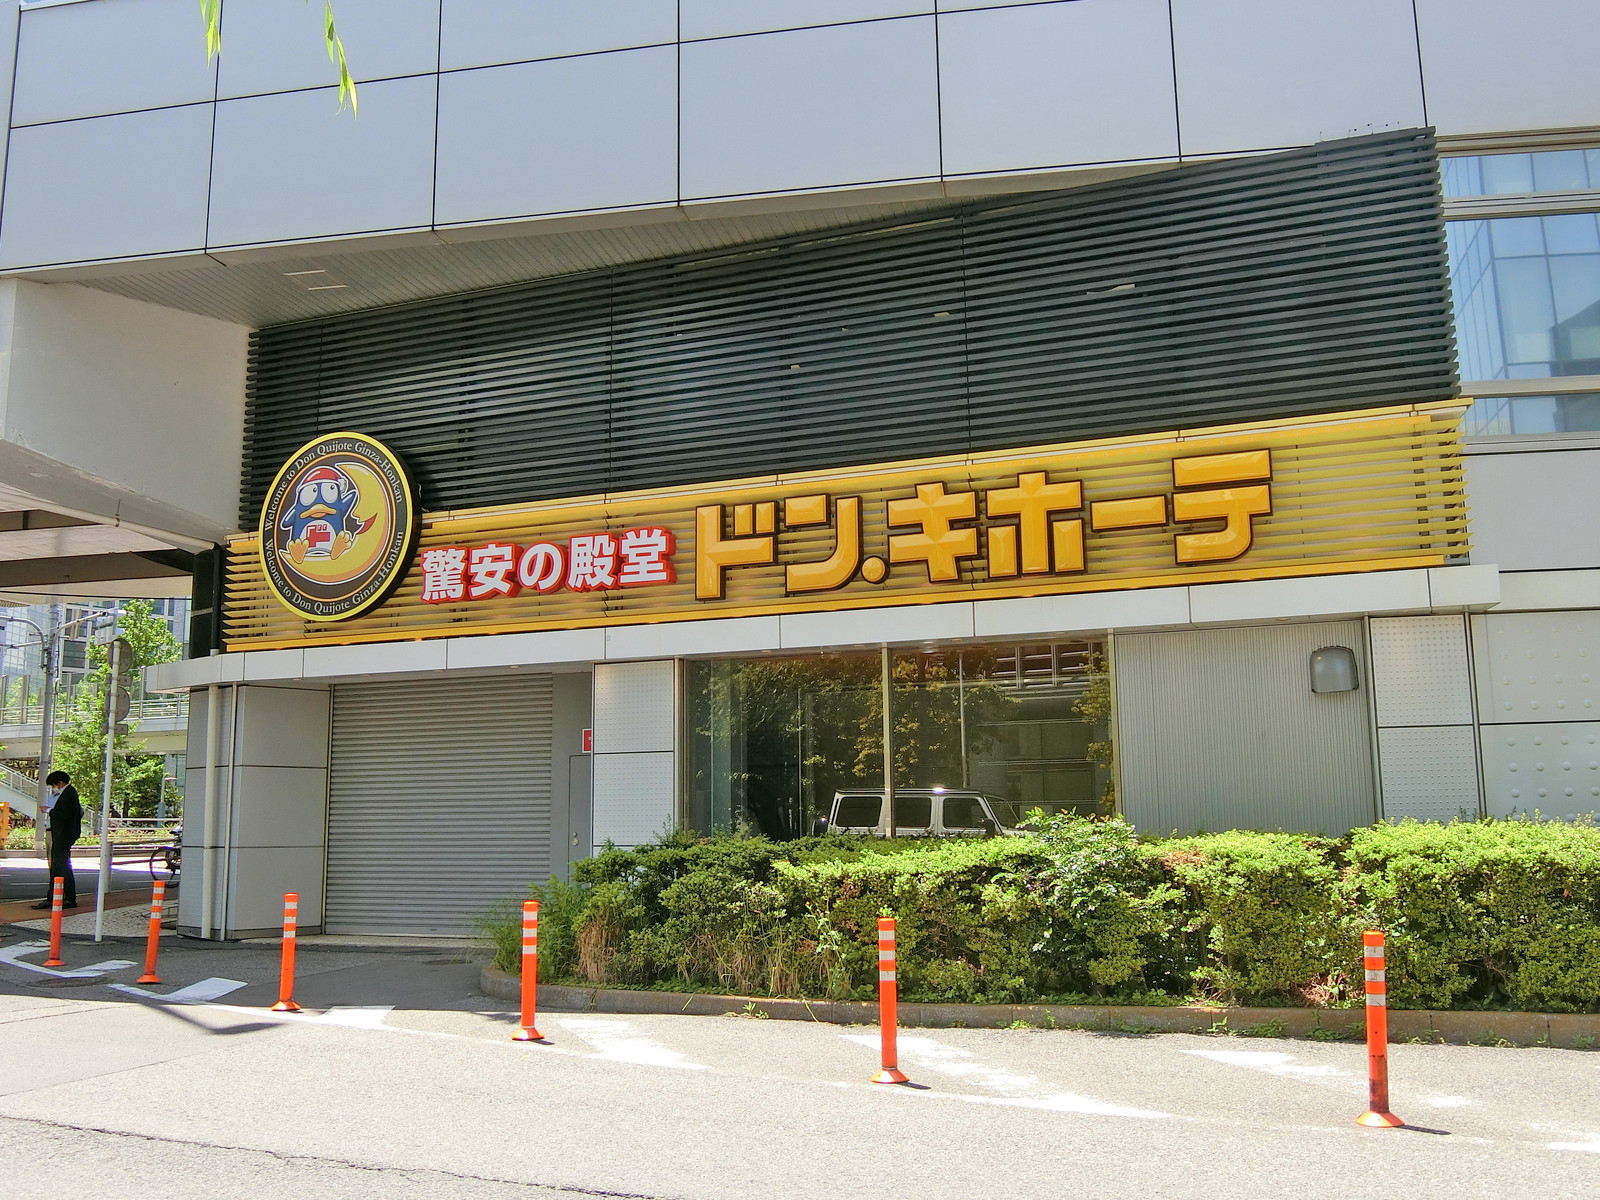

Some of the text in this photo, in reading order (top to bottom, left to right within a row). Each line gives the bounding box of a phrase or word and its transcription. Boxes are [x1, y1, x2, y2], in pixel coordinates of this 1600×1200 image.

[265, 441, 402, 531] Welcome to Don Quijote Ginza-Honkan
[265, 531, 404, 614] Welcome to Don Quijote Ginza-Honkan
[421, 525, 676, 605] 驚安の殿堂
